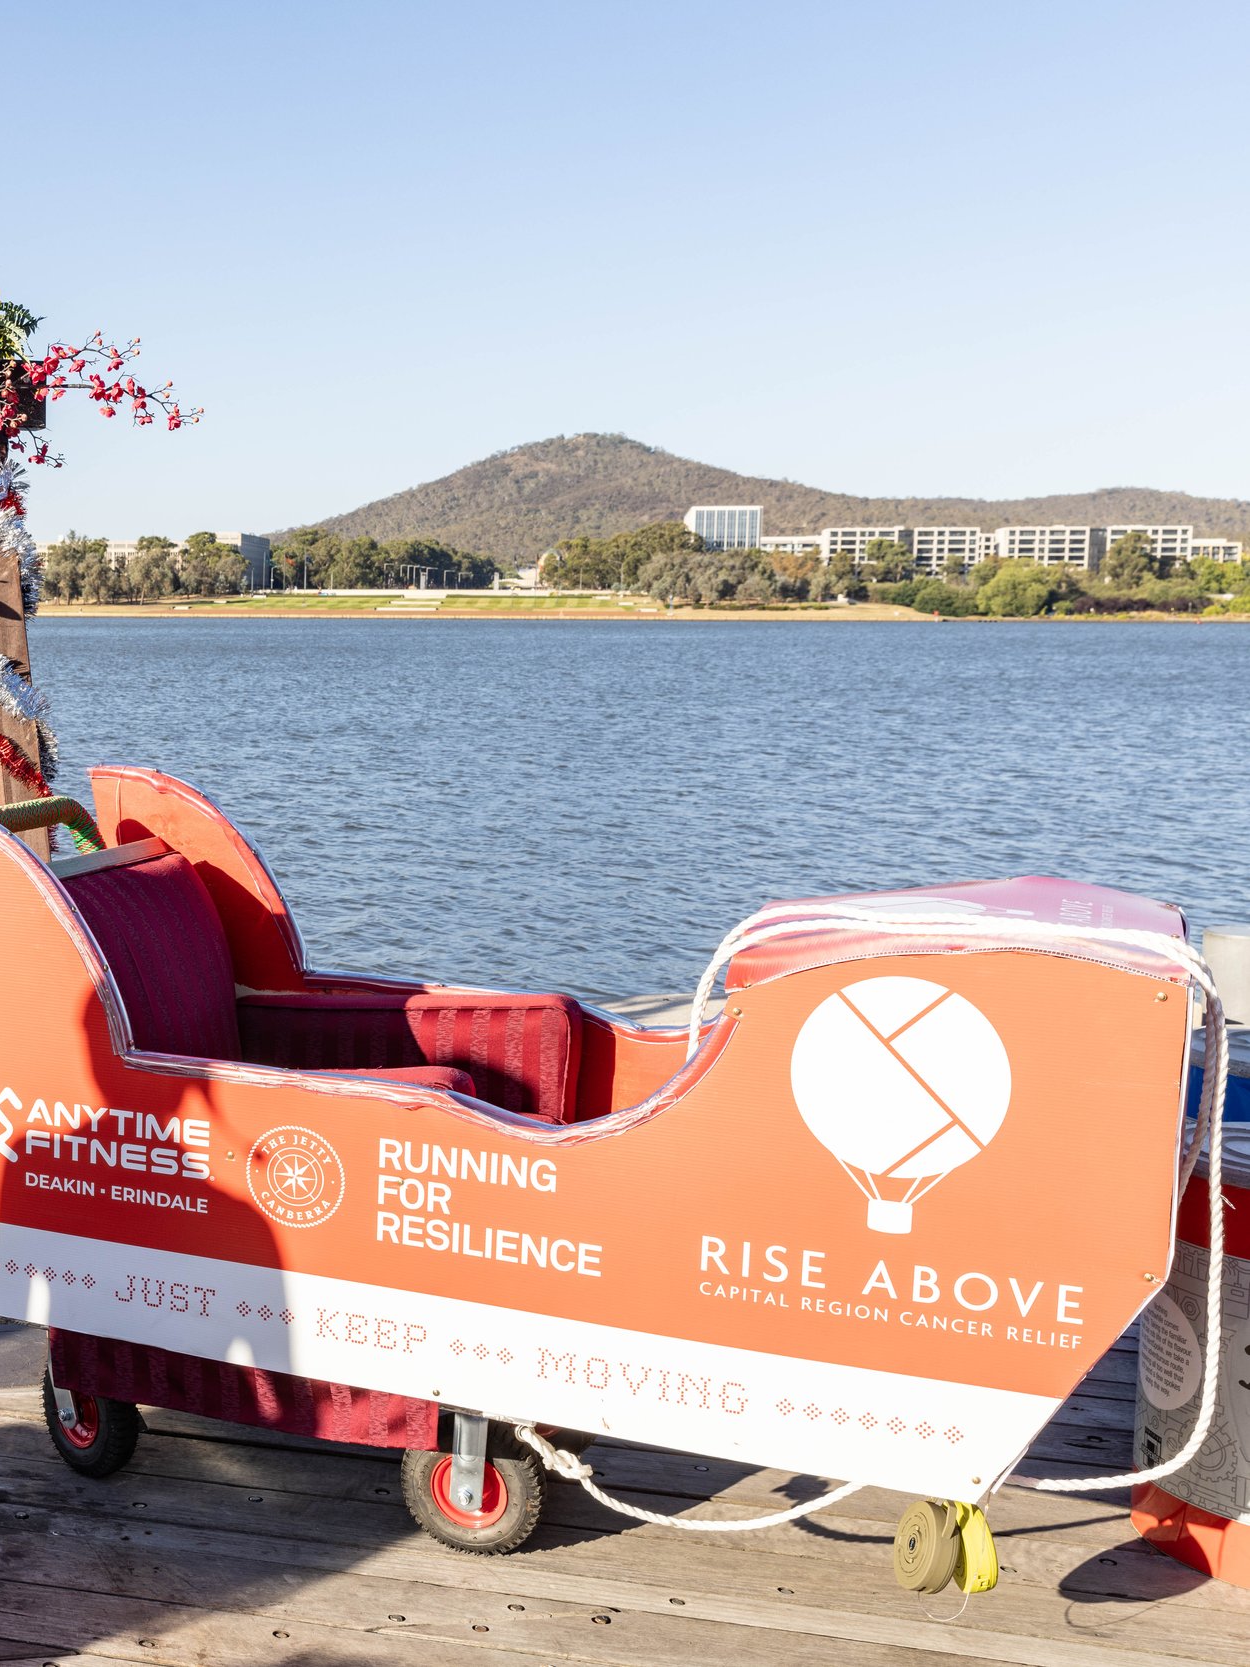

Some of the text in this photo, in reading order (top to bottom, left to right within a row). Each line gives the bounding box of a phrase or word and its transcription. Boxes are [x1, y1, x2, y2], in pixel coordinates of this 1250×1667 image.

[26, 1098, 211, 1148] ANYTIME
[25, 1129, 211, 1181] FITNESS
[261, 1134, 332, 1165] THE JETTY
[378, 1137, 557, 1193] RUNNING
[25, 1171, 208, 1214] DEAKIN ERINDALE
[261, 1191, 330, 1221] CANBERRA
[377, 1173, 452, 1215] FOR
[376, 1210, 603, 1277] RESILIENCE
[700, 1234, 1084, 1326] RISE ABOVE
[699, 1281, 1083, 1350] CAPITAL REGION CANCER RELIEF
[114, 1274, 750, 1415] JUST KEEP MOVING
[1174, 1352, 1184, 1362] take
